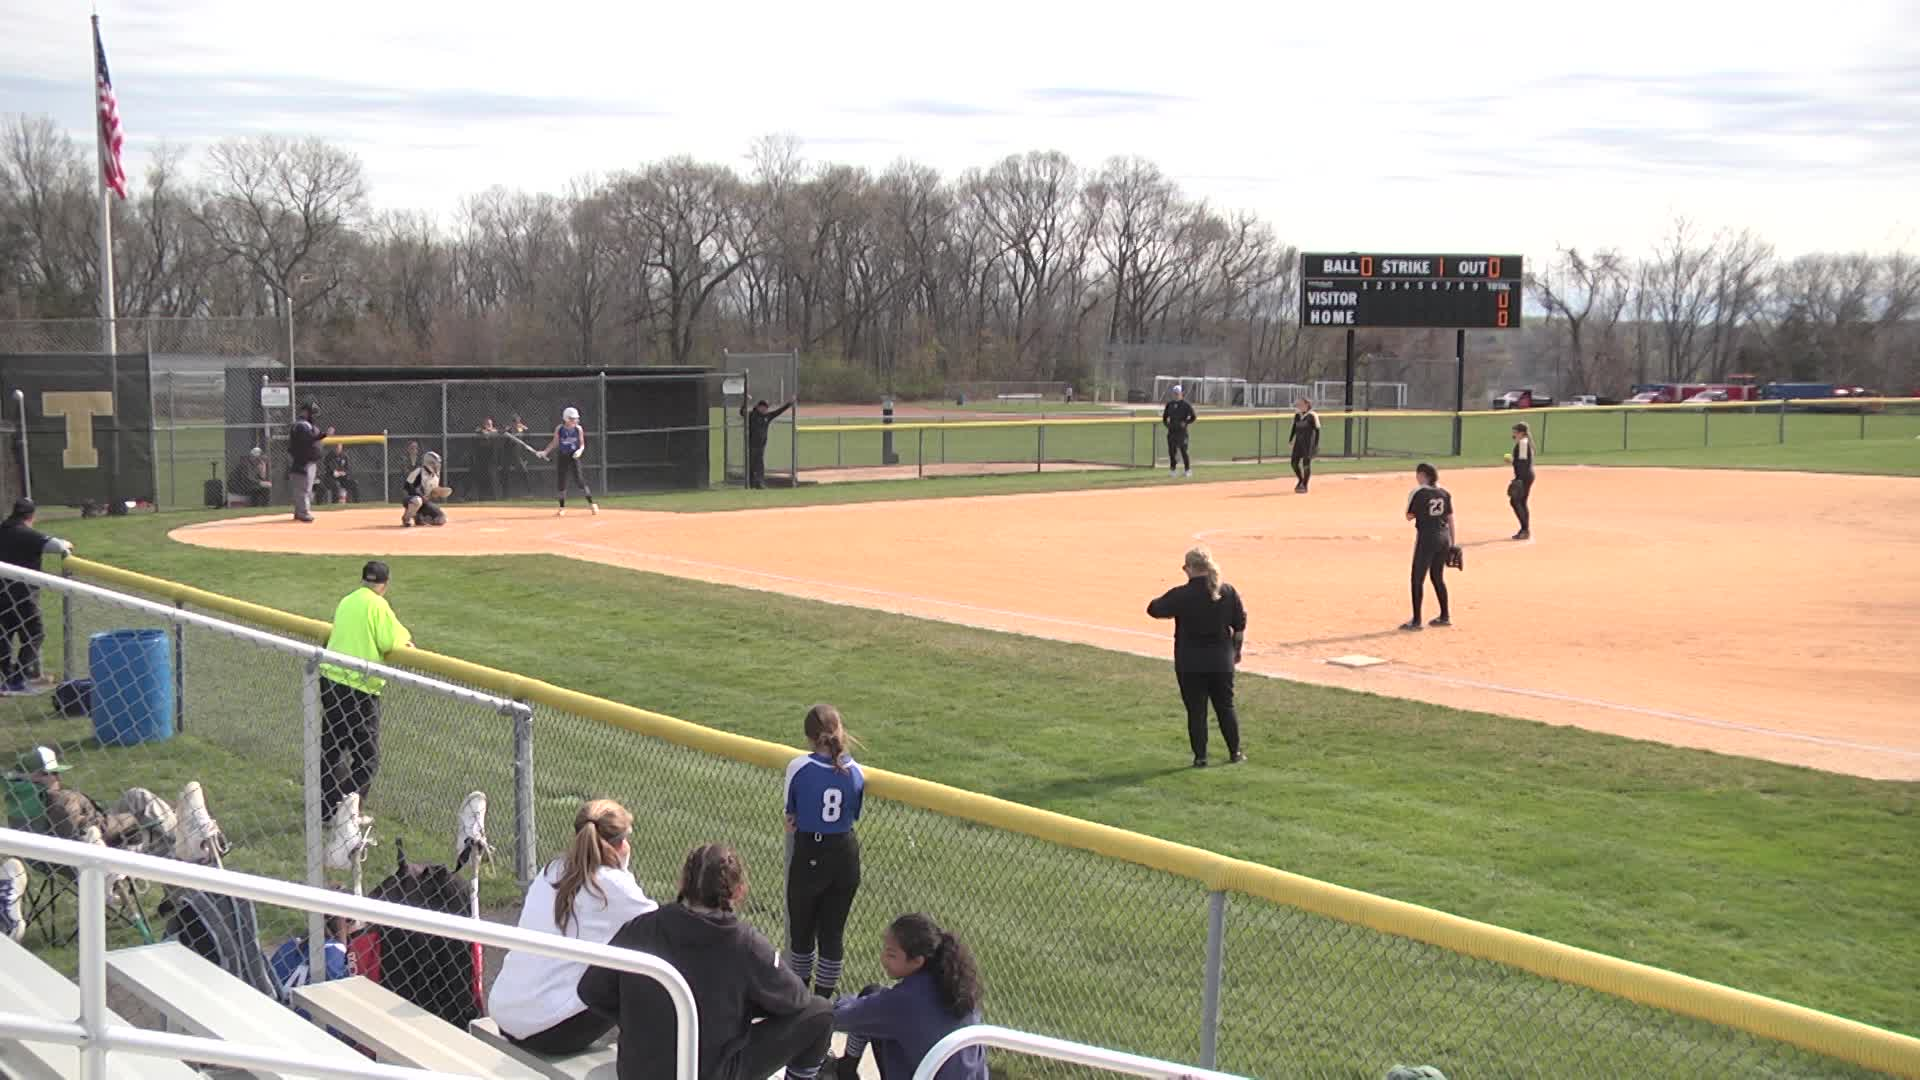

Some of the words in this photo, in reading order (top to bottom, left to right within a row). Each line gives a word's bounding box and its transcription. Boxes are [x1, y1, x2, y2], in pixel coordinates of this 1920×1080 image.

[1323, 259, 1359, 273] BALL
[1360, 256, 1373, 276] 0
[1382, 259, 1431, 274] STRIKE
[1458, 261, 1487, 274] OUT
[1488, 256, 1501, 278] 0
[1362, 281, 1369, 290] 1
[1376, 281, 1383, 290] 2
[1390, 281, 1397, 290] 3
[1403, 281, 1410, 290] 4
[1417, 282, 1424, 290] 5
[1431, 282, 1438, 290] 6
[1445, 282, 1452, 290] 7
[1458, 282, 1465, 290] 8
[1472, 282, 1479, 291] 9
[1307, 291, 1358, 306] VISITOR
[1310, 310, 1355, 324] HOME
[1498, 311, 1508, 326] 0
[41, 391, 113, 468] T
[1429, 498, 1445, 516] 23
[822, 788, 842, 822] 8
